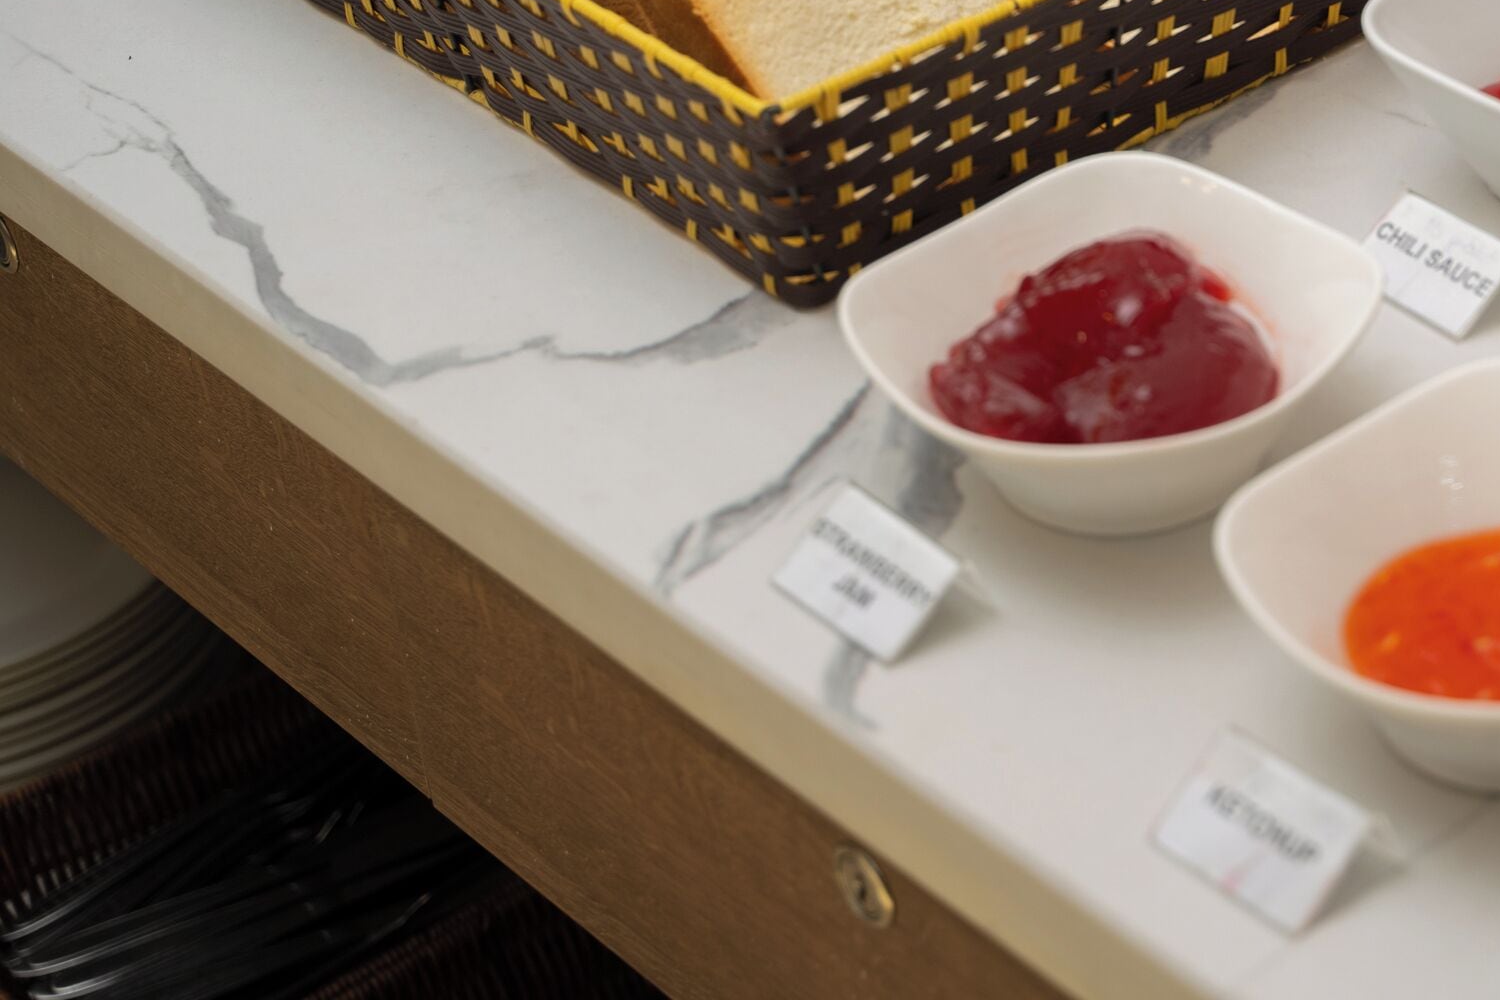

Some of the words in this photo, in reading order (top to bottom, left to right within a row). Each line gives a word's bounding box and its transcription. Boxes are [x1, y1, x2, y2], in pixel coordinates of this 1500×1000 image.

[1376, 221, 1429, 260] CHILI
[1424, 248, 1494, 299] SAUCE
[1204, 782, 1321, 864] KETCHUP
